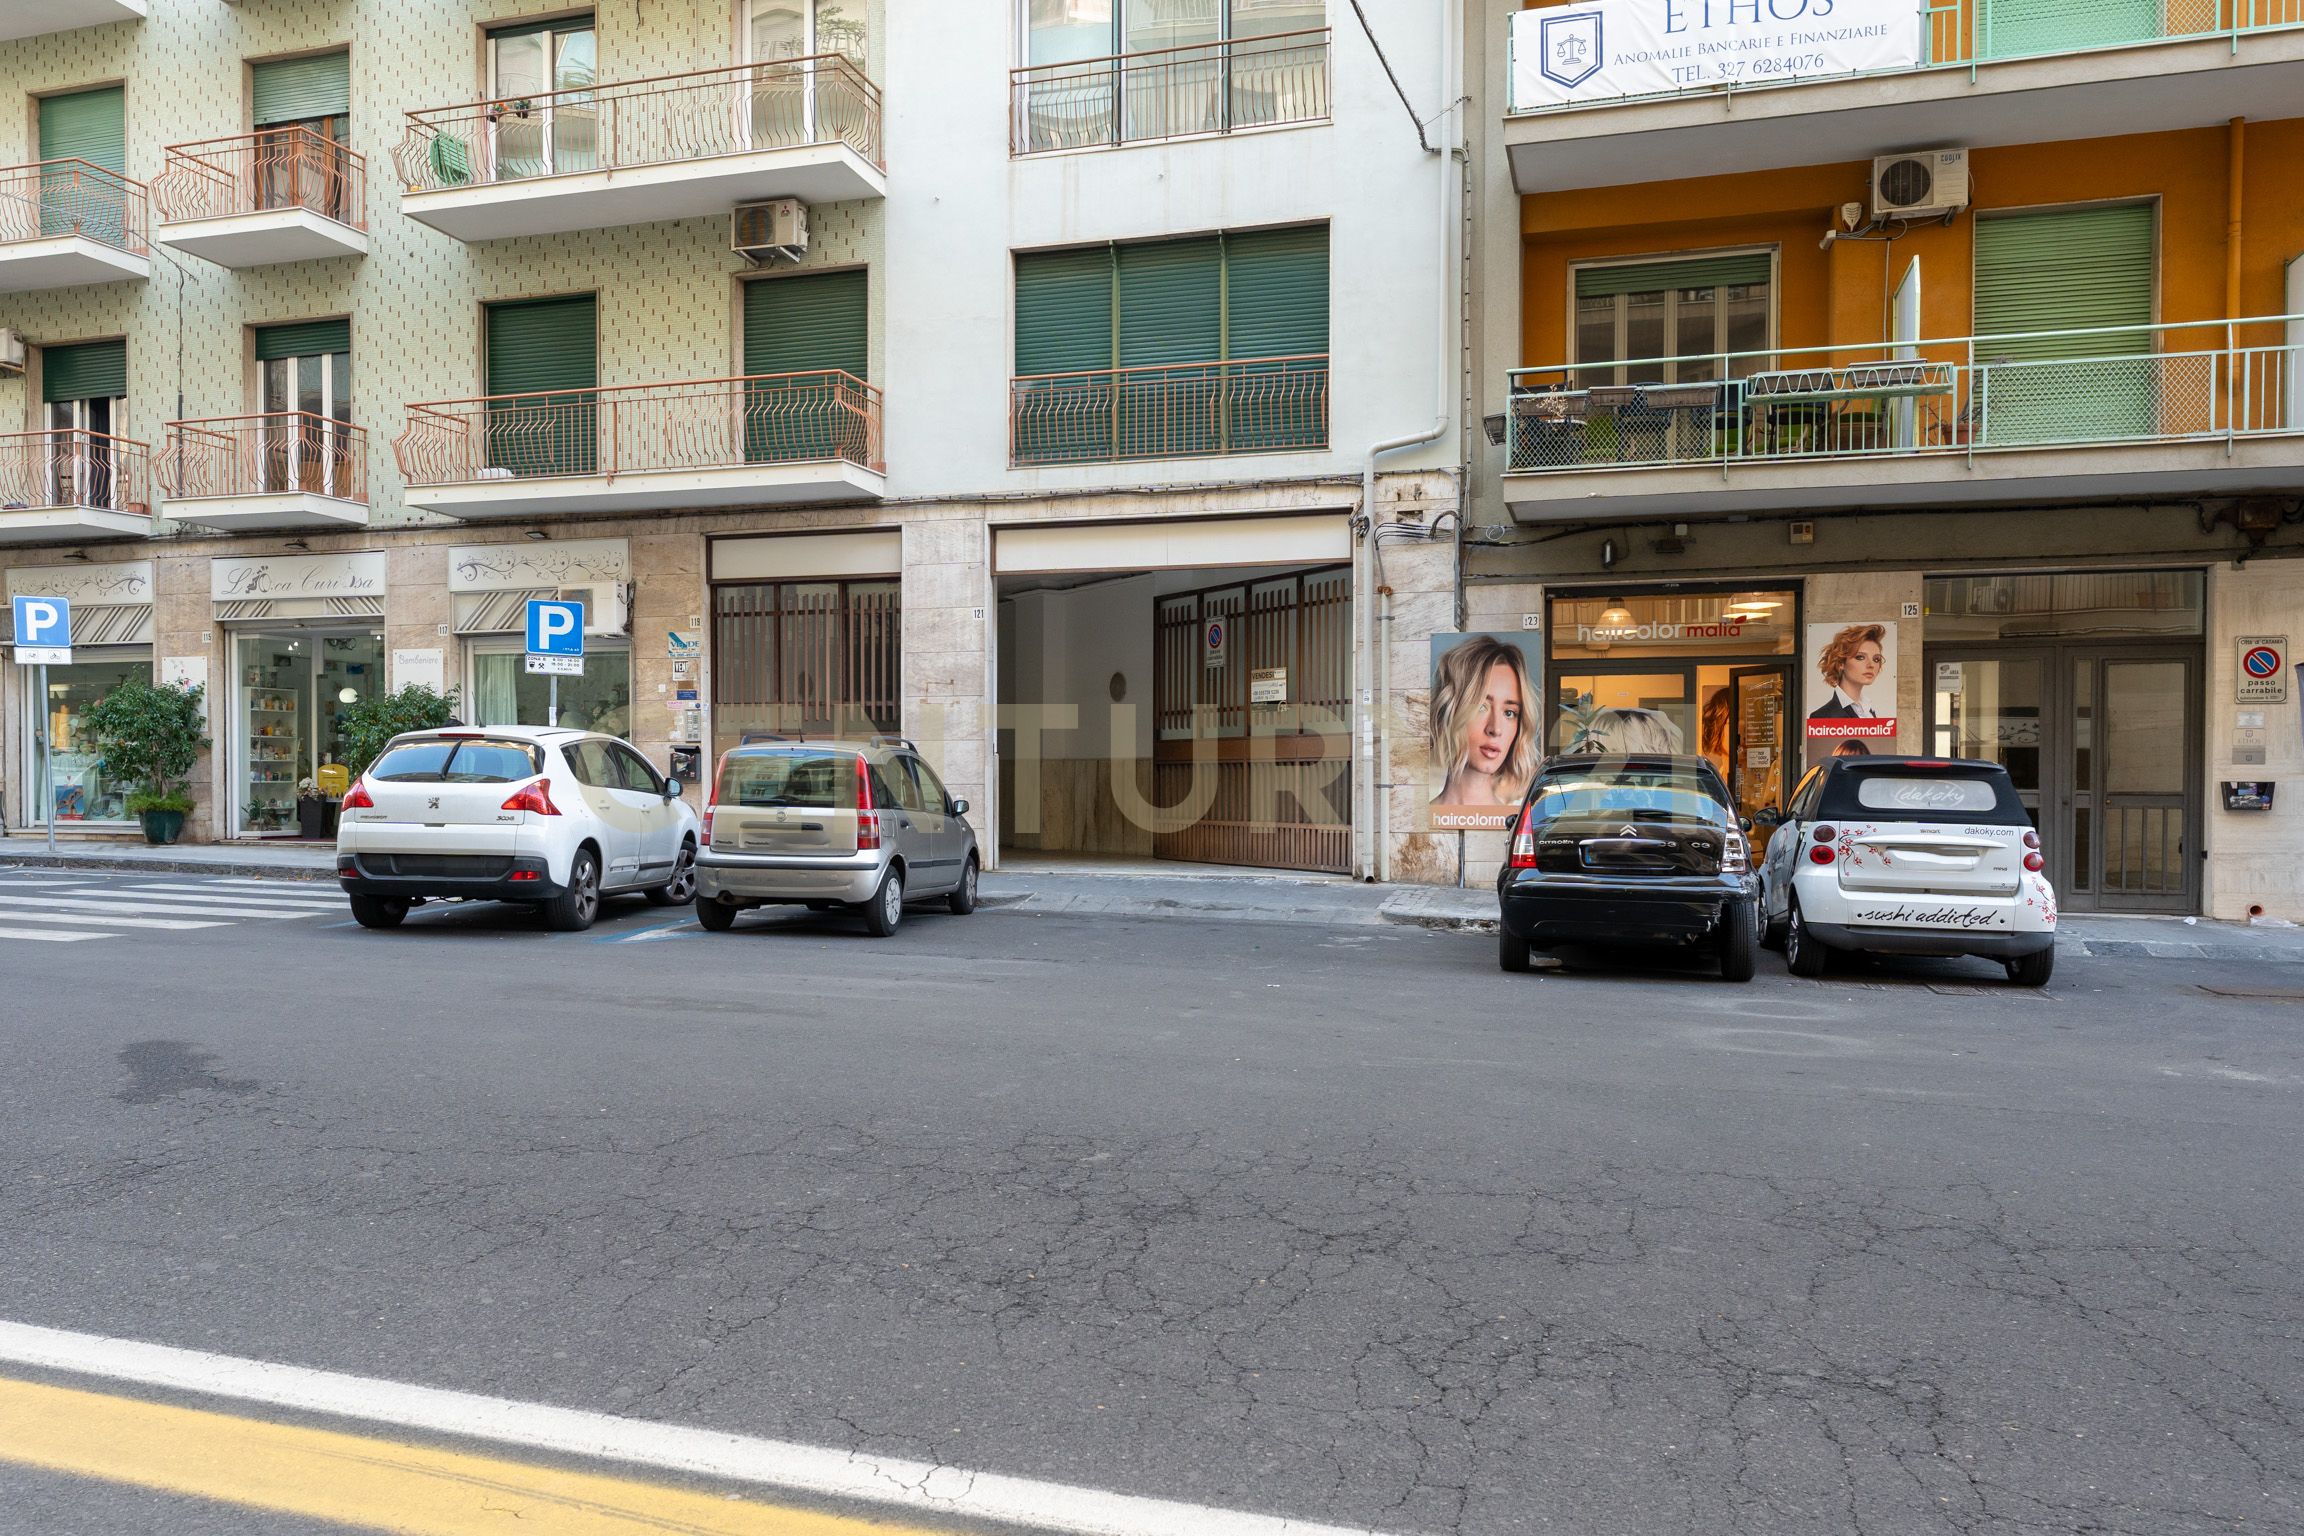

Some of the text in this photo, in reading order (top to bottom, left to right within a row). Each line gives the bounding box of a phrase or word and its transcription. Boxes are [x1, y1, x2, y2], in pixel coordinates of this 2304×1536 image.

[1614, 24, 1888, 66] ANOMALIE BANCARIE E FINANZIARIE
[1672, 53, 1824, 83] TEL. 327 6284076
[974, 608, 984, 619] 121
[1903, 604, 1918, 616] 125
[25, 602, 58, 641] P
[539, 605, 574, 649] P
[439, 625, 448, 635] 117
[1577, 621, 1682, 641] haircolor
[203, 632, 212, 642] 115
[1252, 671, 1275, 680] VENDESI
[2240, 686, 2283, 694] carrabile
[1432, 813, 1506, 826] haircolorm
[1964, 827, 2014, 837] dakoky.com
[1864, 904, 1998, 927] sushi addicted
